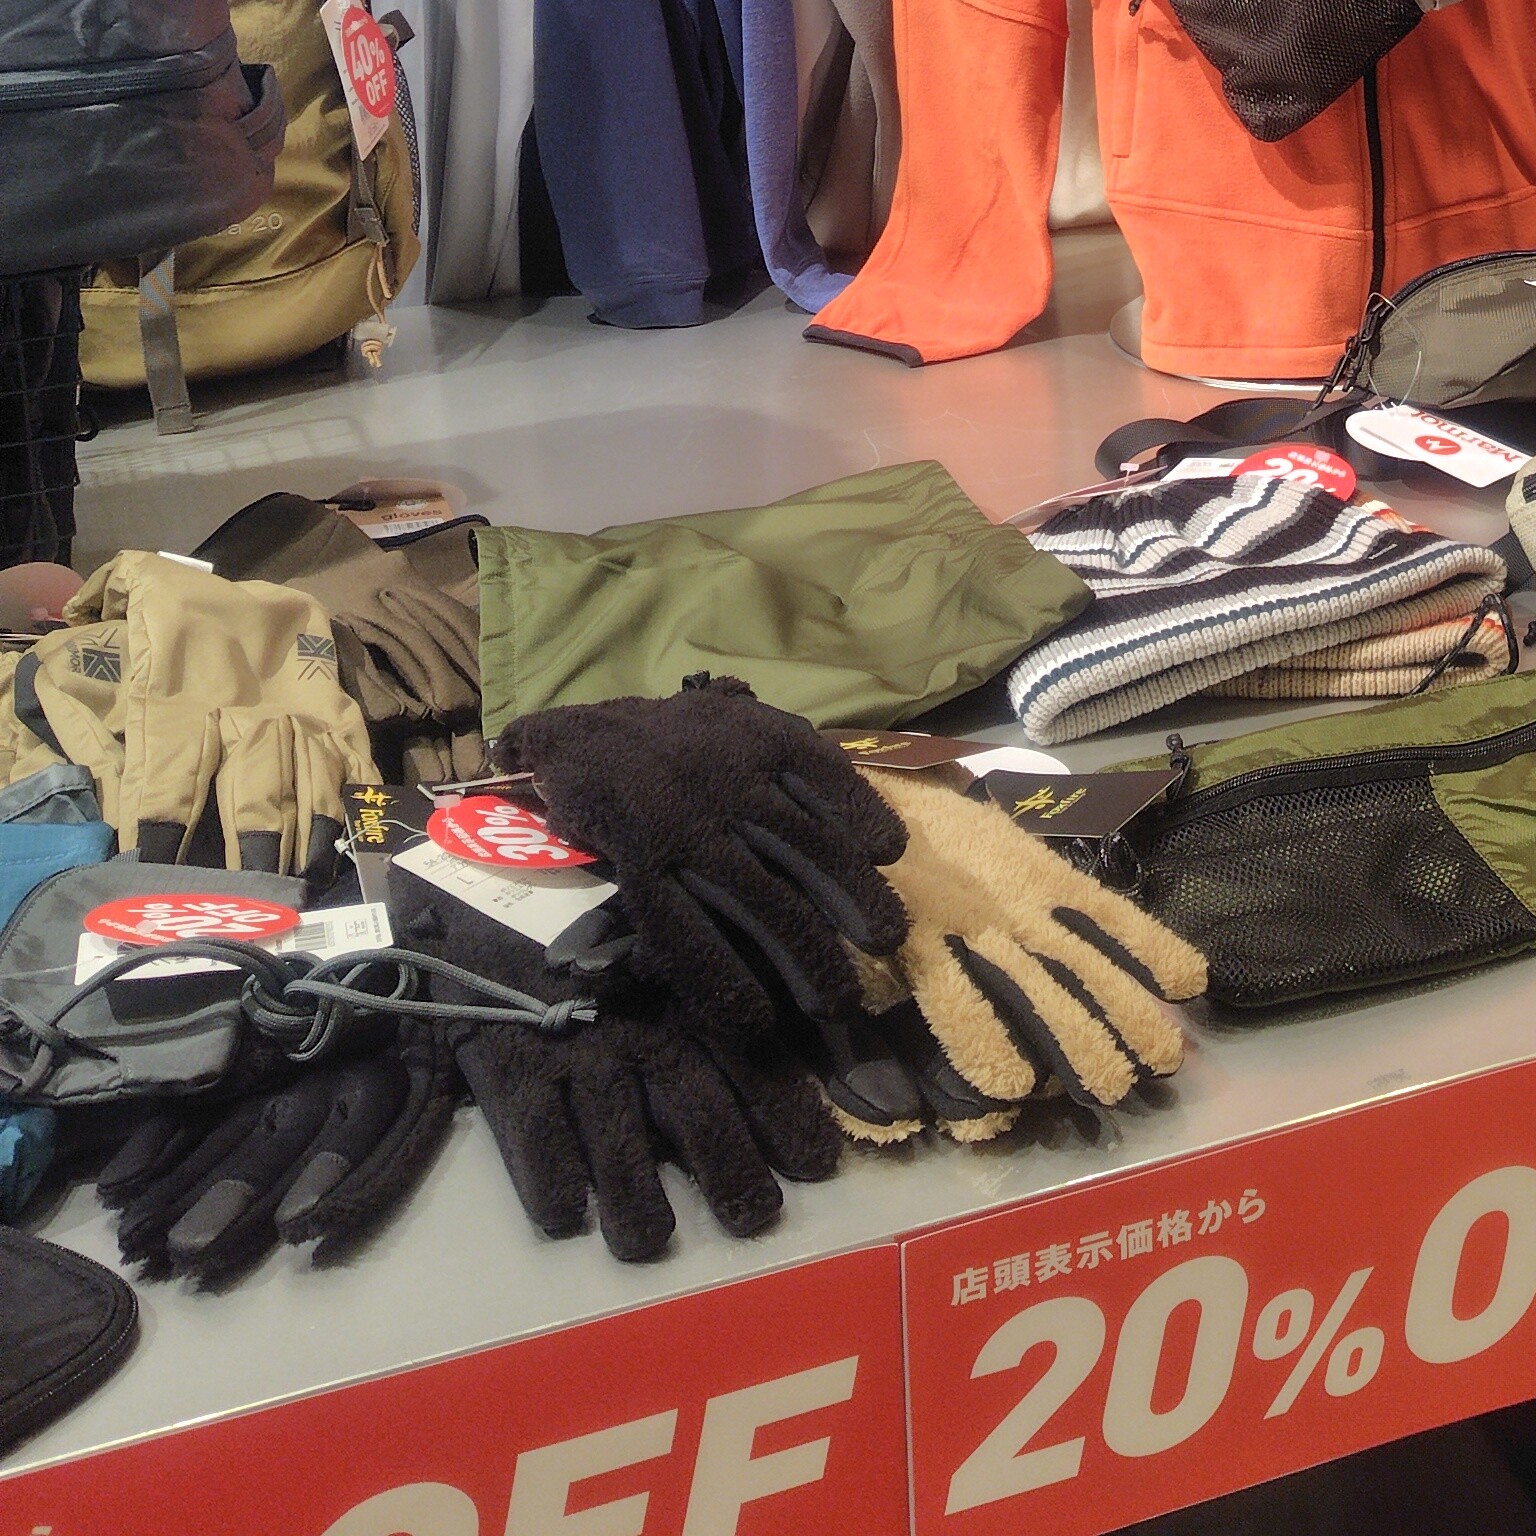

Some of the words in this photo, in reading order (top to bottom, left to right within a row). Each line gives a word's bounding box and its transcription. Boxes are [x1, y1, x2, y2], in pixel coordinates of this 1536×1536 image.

[350, 34, 386, 82] 40%
[365, 68, 388, 107] OFF
[252, 212, 284, 234] 20
[1410, 409, 1524, 463] Marmot
[475, 805, 570, 862] 30%
[126, 902, 265, 937] 20%
[182, 902, 281, 923] OFF
[950, 1187, 1267, 1307] 店頭表示価格から
